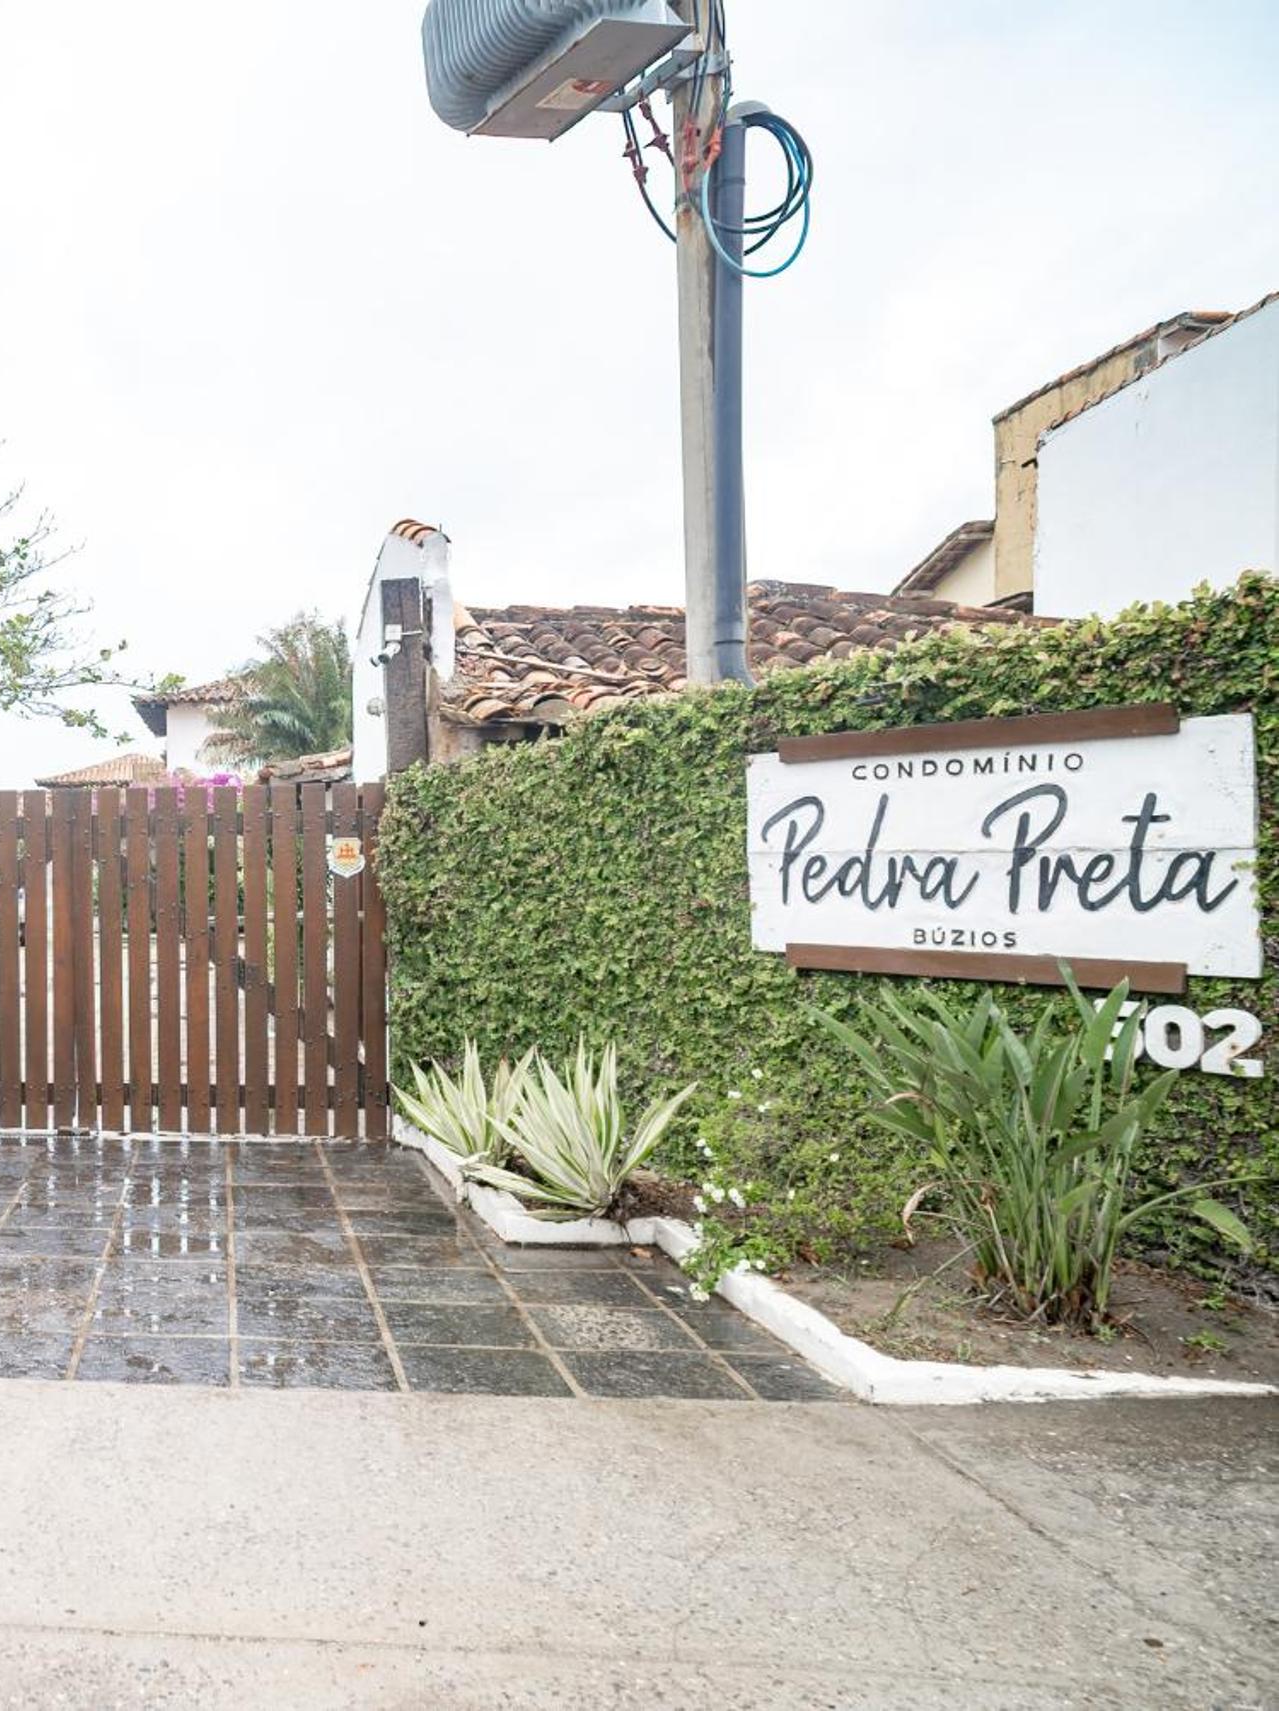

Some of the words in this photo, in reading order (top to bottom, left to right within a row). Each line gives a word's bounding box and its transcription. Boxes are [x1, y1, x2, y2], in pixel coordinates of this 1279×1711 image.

[852, 752, 1084, 780] CONDOMÍNIO
[761, 793, 980, 910] Pedra
[981, 783, 1240, 914] Preta
[913, 926, 1017, 948] BÚZIOS
